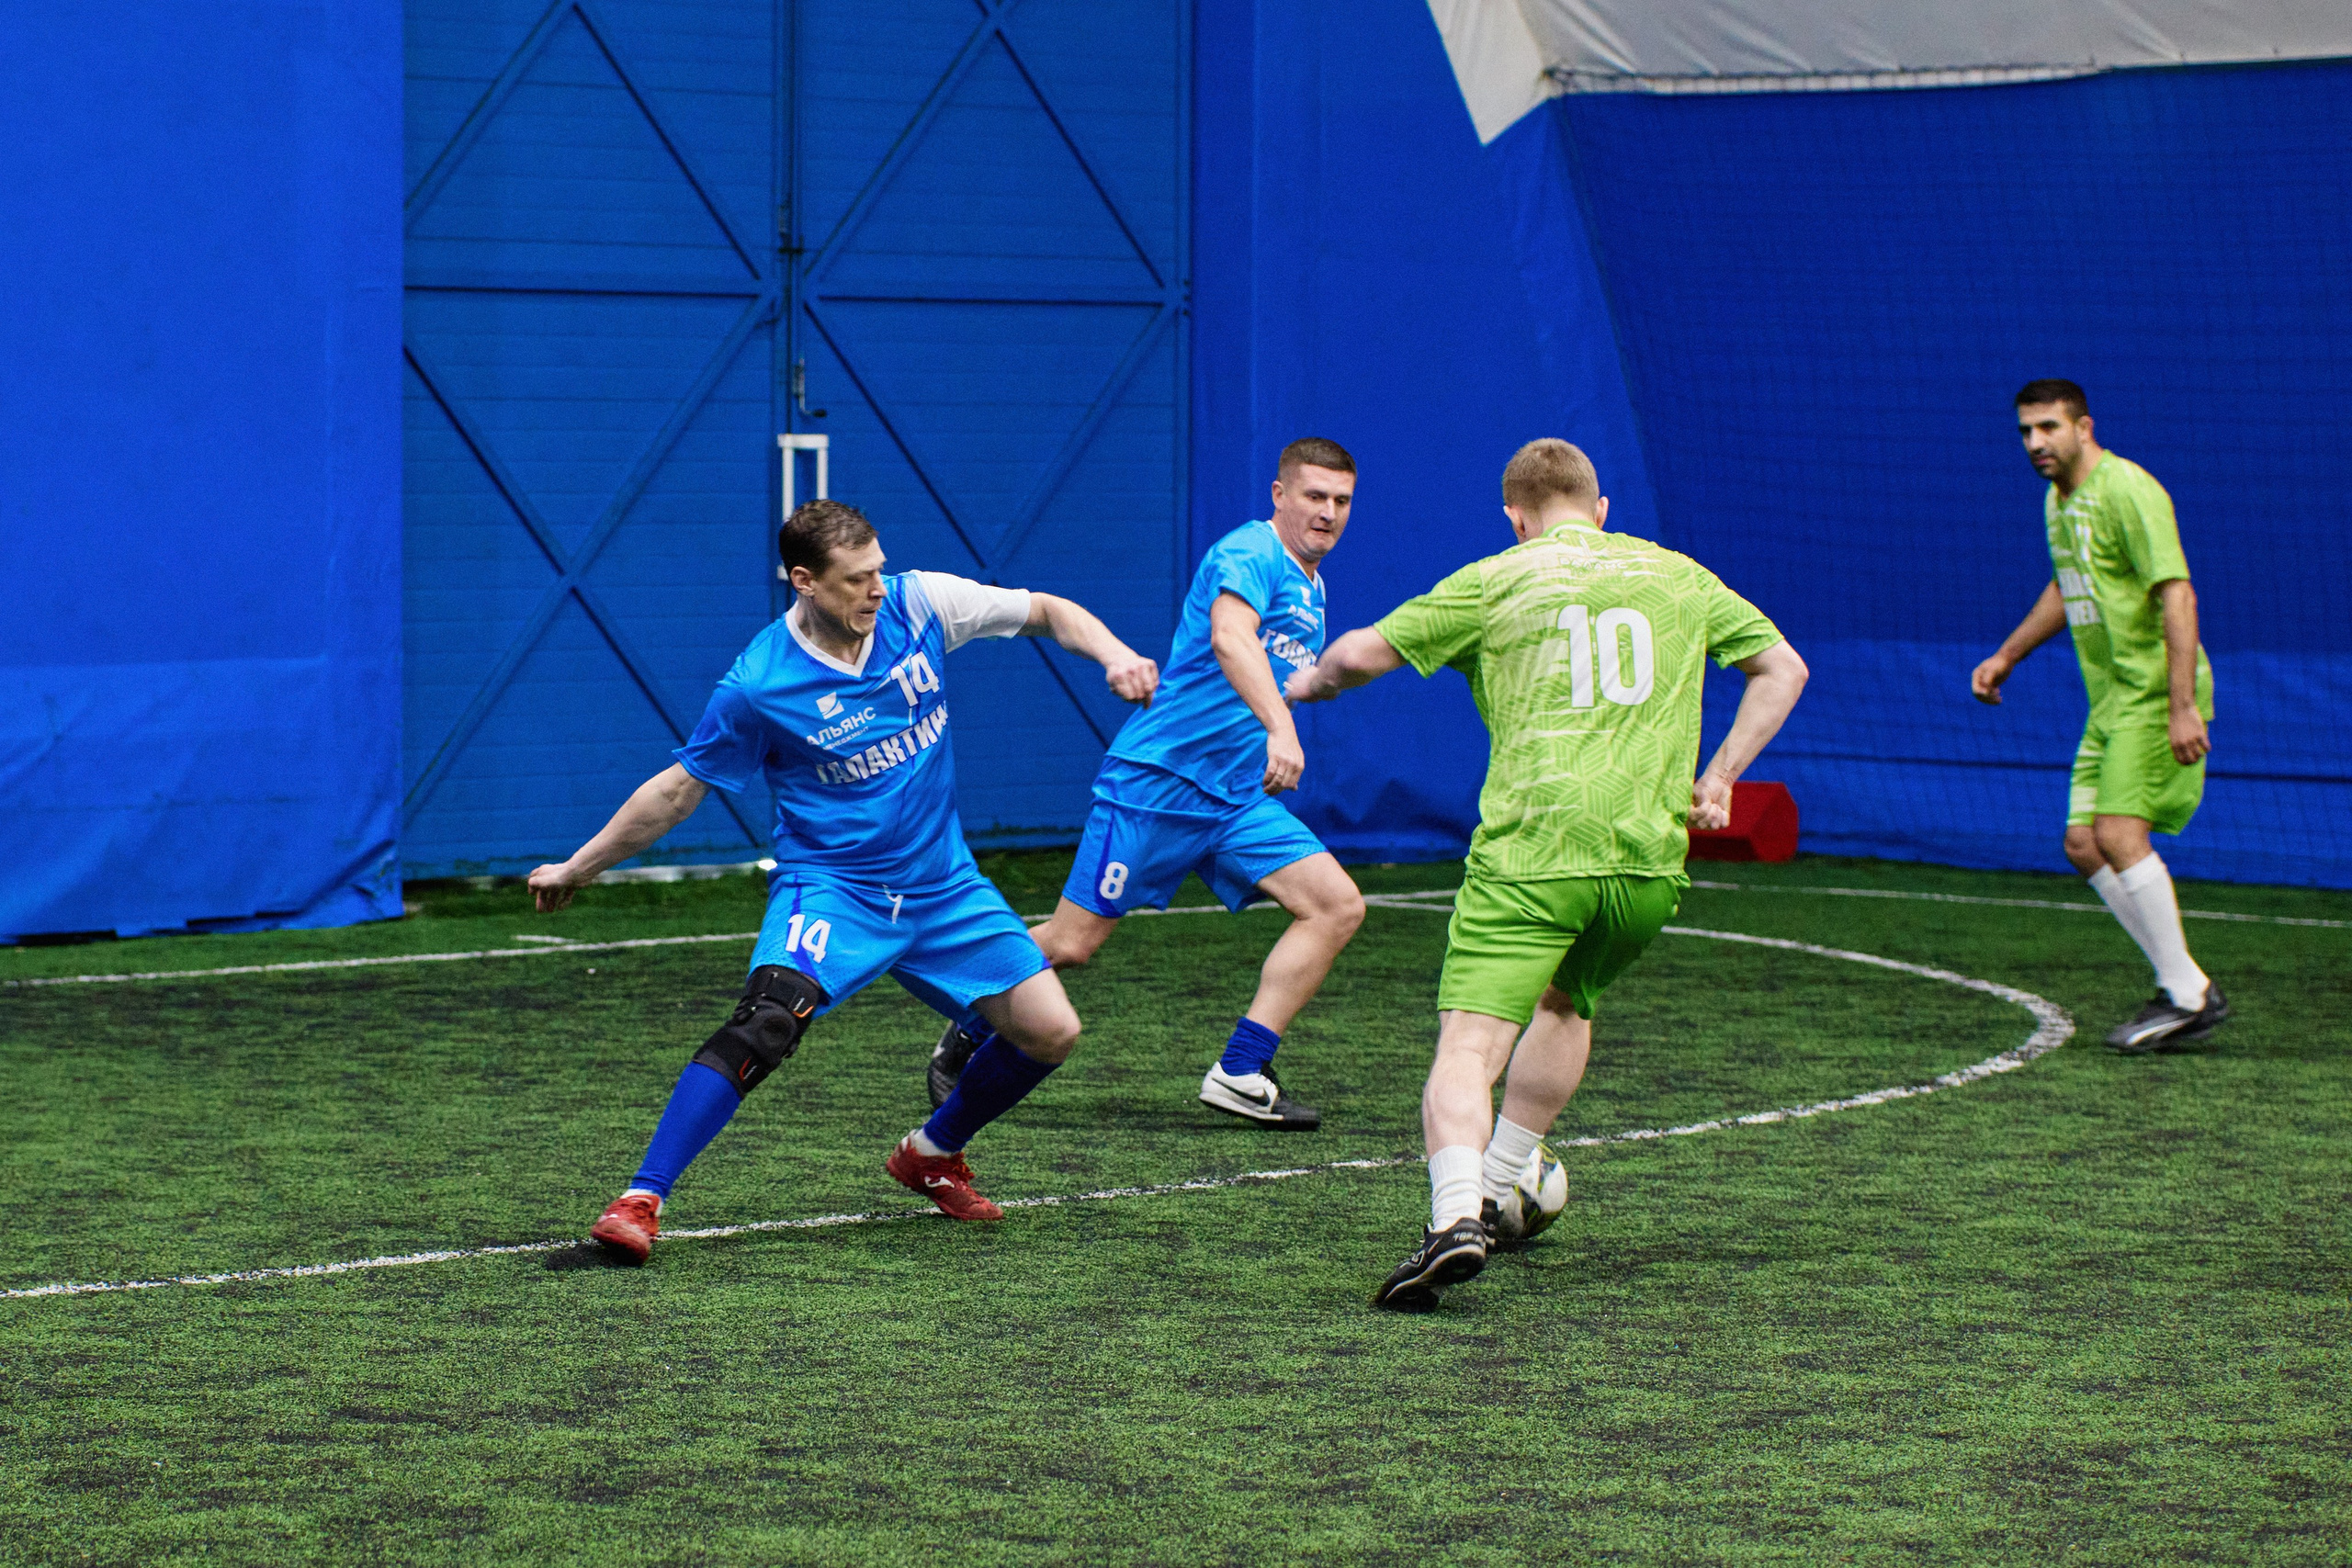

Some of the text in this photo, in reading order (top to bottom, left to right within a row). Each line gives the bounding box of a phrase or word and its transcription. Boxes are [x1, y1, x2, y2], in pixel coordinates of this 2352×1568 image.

[889, 650, 940, 707] 14
[1557, 604, 1654, 707] 10
[806, 706, 876, 745] АЛЬЯНС
[1099, 861, 1129, 899] 8
[785, 913, 831, 964] 14
